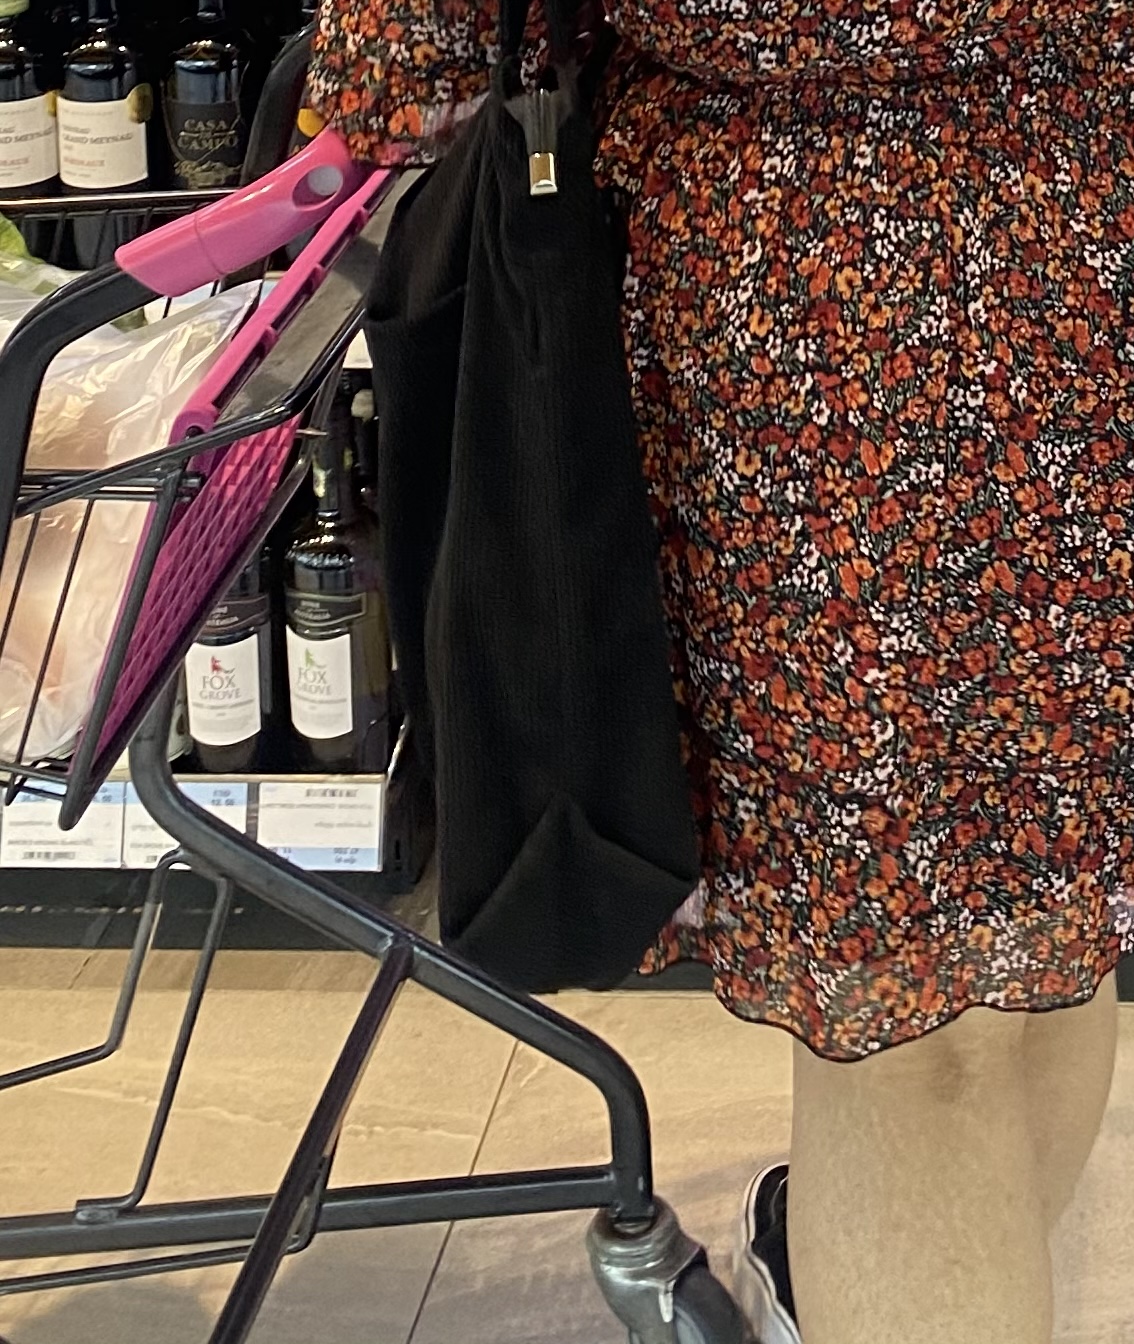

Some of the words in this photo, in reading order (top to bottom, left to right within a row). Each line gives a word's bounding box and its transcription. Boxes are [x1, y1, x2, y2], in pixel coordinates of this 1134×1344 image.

[184, 119, 227, 131] CASA
[202, 674, 236, 690] FOX
[298, 667, 328, 685] FOX
[199, 688, 242, 700] GROVE
